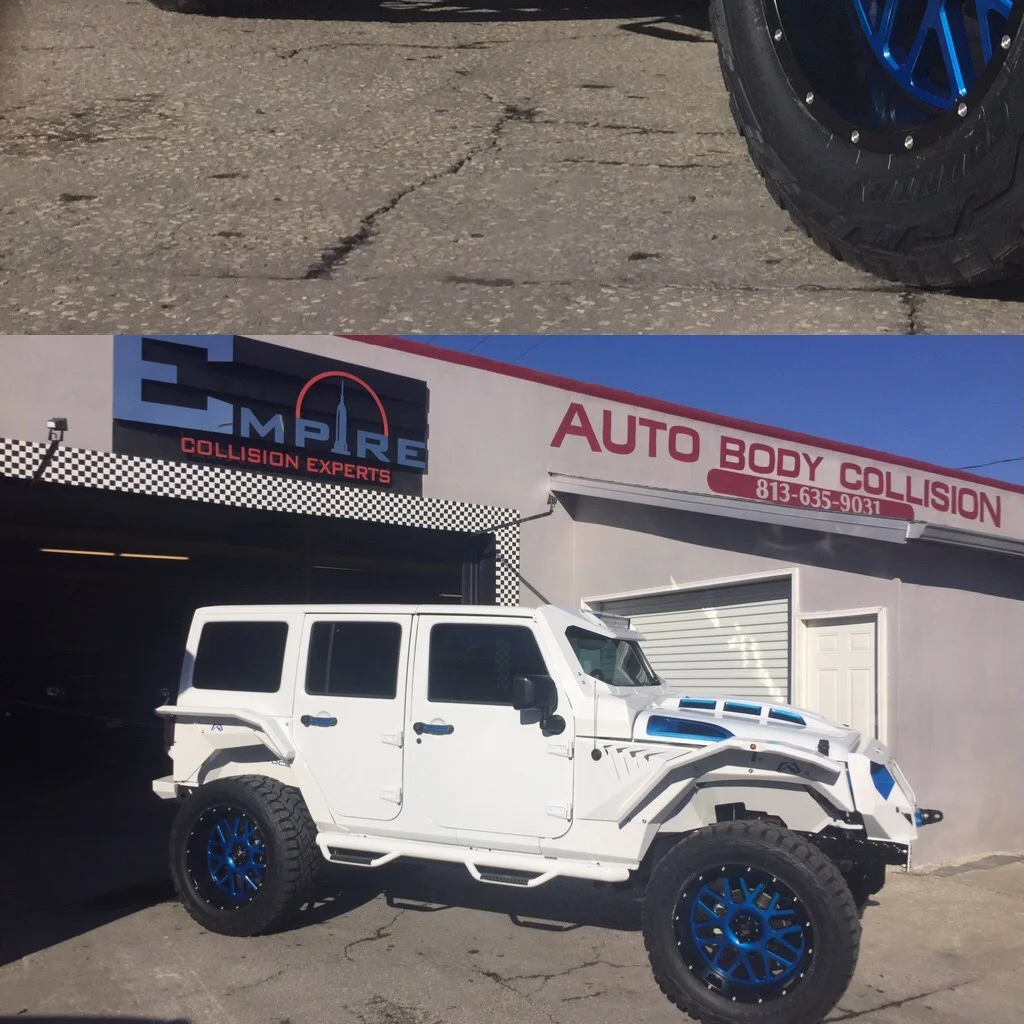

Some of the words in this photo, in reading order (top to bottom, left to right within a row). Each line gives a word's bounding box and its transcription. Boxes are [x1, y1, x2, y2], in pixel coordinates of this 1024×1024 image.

[113, 335, 426, 468] EMPIRE
[181, 437, 299, 470] COLLISION
[306, 457, 391, 484] EXPERTS
[550, 402, 700, 463] AUTO
[719, 435, 824, 482] BODY
[839, 462, 1002, 528] COLLISION
[756, 478, 881, 516] 813-635-9031
